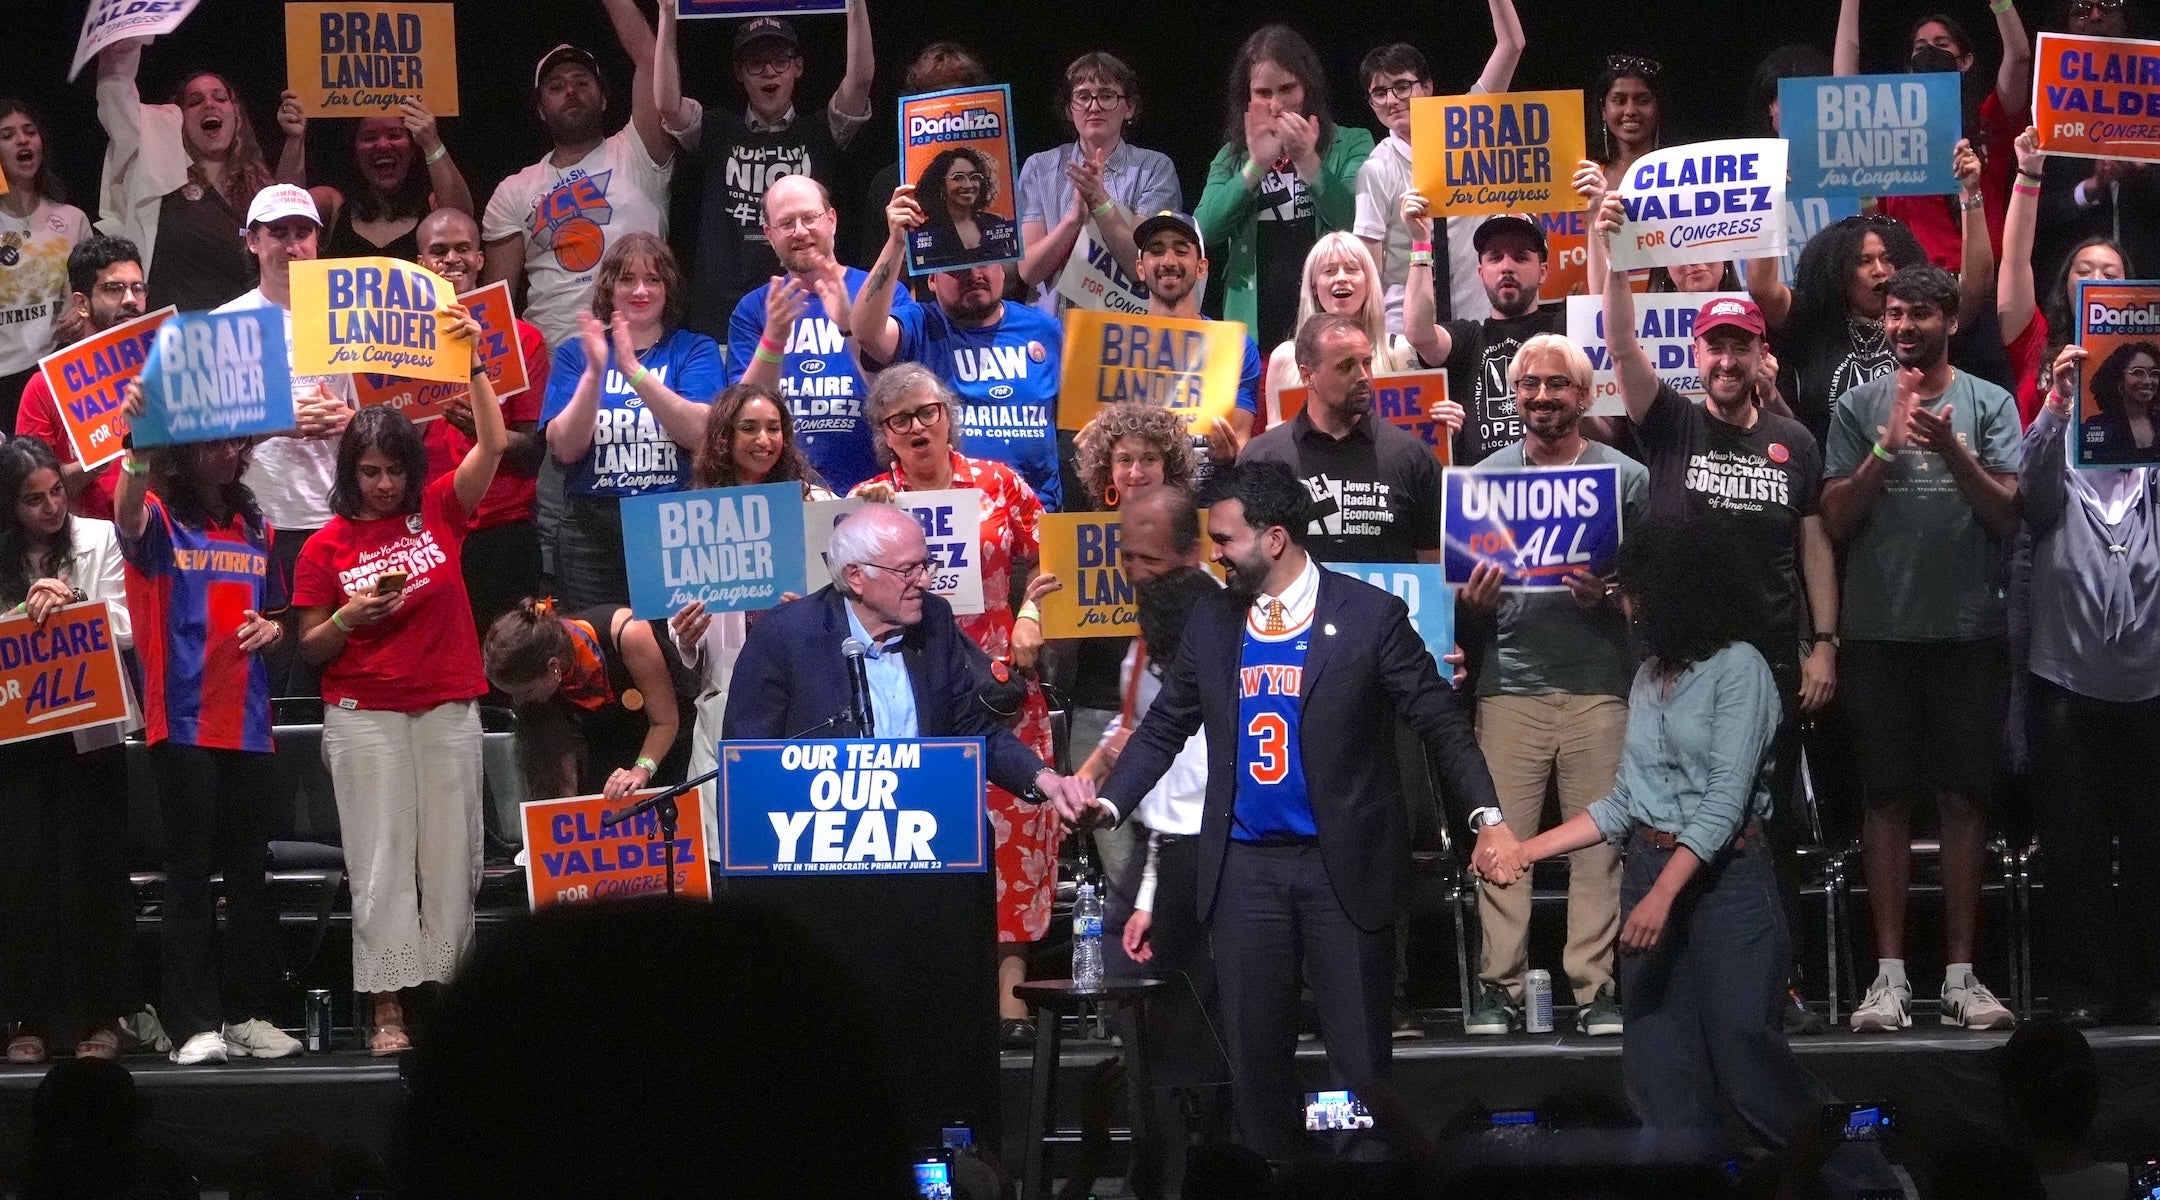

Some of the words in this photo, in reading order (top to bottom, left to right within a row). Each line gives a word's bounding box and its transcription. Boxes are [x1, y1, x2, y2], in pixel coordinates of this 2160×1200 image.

[320, 12, 422, 54] BRAD
[321, 55, 423, 89] LANDER
[2060, 50, 2160, 85] CLAIR
[321, 91, 350, 108] for
[352, 90, 423, 110] Congres
[1817, 83, 1928, 130] BRAD
[2046, 85, 2160, 117] VALDE
[910, 111, 999, 137] Darializa
[911, 136, 931, 145] FOR
[936, 130, 1000, 141] CONGRESS
[1445, 103, 1549, 149] BRAD
[2054, 122, 2084, 138] FOR
[2089, 121, 2160, 142] CONGRE
[1818, 128, 1928, 167] LANDER
[1445, 147, 1551, 187] LANDER
[1634, 153, 1759, 190] CLAIRE
[1818, 170, 1848, 188] for
[1852, 168, 1928, 190] Congress
[531, 177, 608, 236] ICE
[729, 191, 745, 199] FOR
[1445, 189, 1474, 207] for
[1478, 187, 1551, 208] Congress
[1622, 186, 1772, 222] VALDEZ
[1637, 231, 1665, 249] FOR
[1670, 217, 1762, 248] CONGRESS
[1786, 198, 1829, 242] AD
[1087, 238, 1150, 300] VALD
[1559, 246, 1587, 269] FO
[328, 267, 437, 312] BRAD
[1082, 277, 1105, 297] FOR
[0, 304, 47, 326] UNRISE
[328, 310, 436, 350] LANDER
[160, 316, 263, 374] BRAD
[328, 346, 360, 365] for
[363, 345, 435, 368] Congress
[1102, 323, 1206, 373] BRAD
[954, 346, 1027, 382] UAW
[67, 377, 131, 424] VAL
[162, 363, 266, 410] LANDER
[779, 376, 853, 397] CLAIRE
[1098, 367, 1204, 408] LANDER
[1596, 381, 1620, 398] FO
[201, 407, 266, 431] Congress
[784, 399, 862, 416] LDEZ
[89, 424, 111, 448] FOR
[594, 407, 672, 445] BRA
[793, 419, 856, 433] CONGRESS
[959, 428, 982, 437] FOR
[986, 428, 1045, 438] CONGRESS
[594, 442, 678, 474] LANDER
[1689, 454, 1788, 483] DEMOCRATIC
[1707, 449, 1727, 460] New
[1748, 454, 1768, 467] City
[592, 475, 616, 490] for
[617, 473, 678, 490] Congress
[1343, 480, 1371, 492] Jews
[1373, 481, 1390, 495] For
[1685, 468, 1789, 506] SOCIALISTS
[1343, 494, 1376, 507] Racial
[1378, 495, 1388, 508] &
[1462, 476, 1599, 522] UNIONS
[1708, 496, 1720, 508] of
[1720, 497, 1764, 512] America
[659, 495, 770, 549] BRAD
[1343, 508, 1394, 523] Economic
[1343, 522, 1381, 536] Justice
[173, 548, 209, 571] NEW
[211, 550, 251, 572] YORK
[359, 550, 381, 564] New
[1470, 528, 1516, 555] FOR
[1514, 523, 1591, 567] ALL
[661, 540, 774, 588] LANDER
[401, 577, 430, 597] erica
[665, 585, 697, 609] for
[697, 582, 774, 608] Congress
[1078, 568, 1135, 606] LAN
[1077, 608, 1108, 627] for
[0, 618, 109, 672] DICARE
[0, 679, 22, 706] OR
[25, 662, 96, 714] ALL
[1264, 664, 1304, 697] YO
[781, 745, 838, 771] OUR
[846, 743, 920, 769] TEAM
[1248, 712, 1289, 785] 3
[810, 770, 899, 811] OUR
[552, 810, 678, 845] CLAIR
[768, 810, 938, 863] YEAR
[541, 839, 696, 877] VALDEZ
[772, 863, 792, 871] VOTE
[804, 863, 818, 871] THE
[819, 863, 869, 871] DEMOCRATIC
[871, 862, 908, 870] PRIMARY
[909, 862, 929, 870] JUNE
[930, 861, 942, 869] 23
[557, 885, 589, 903] FOR
[593, 870, 687, 898] CONGRES
